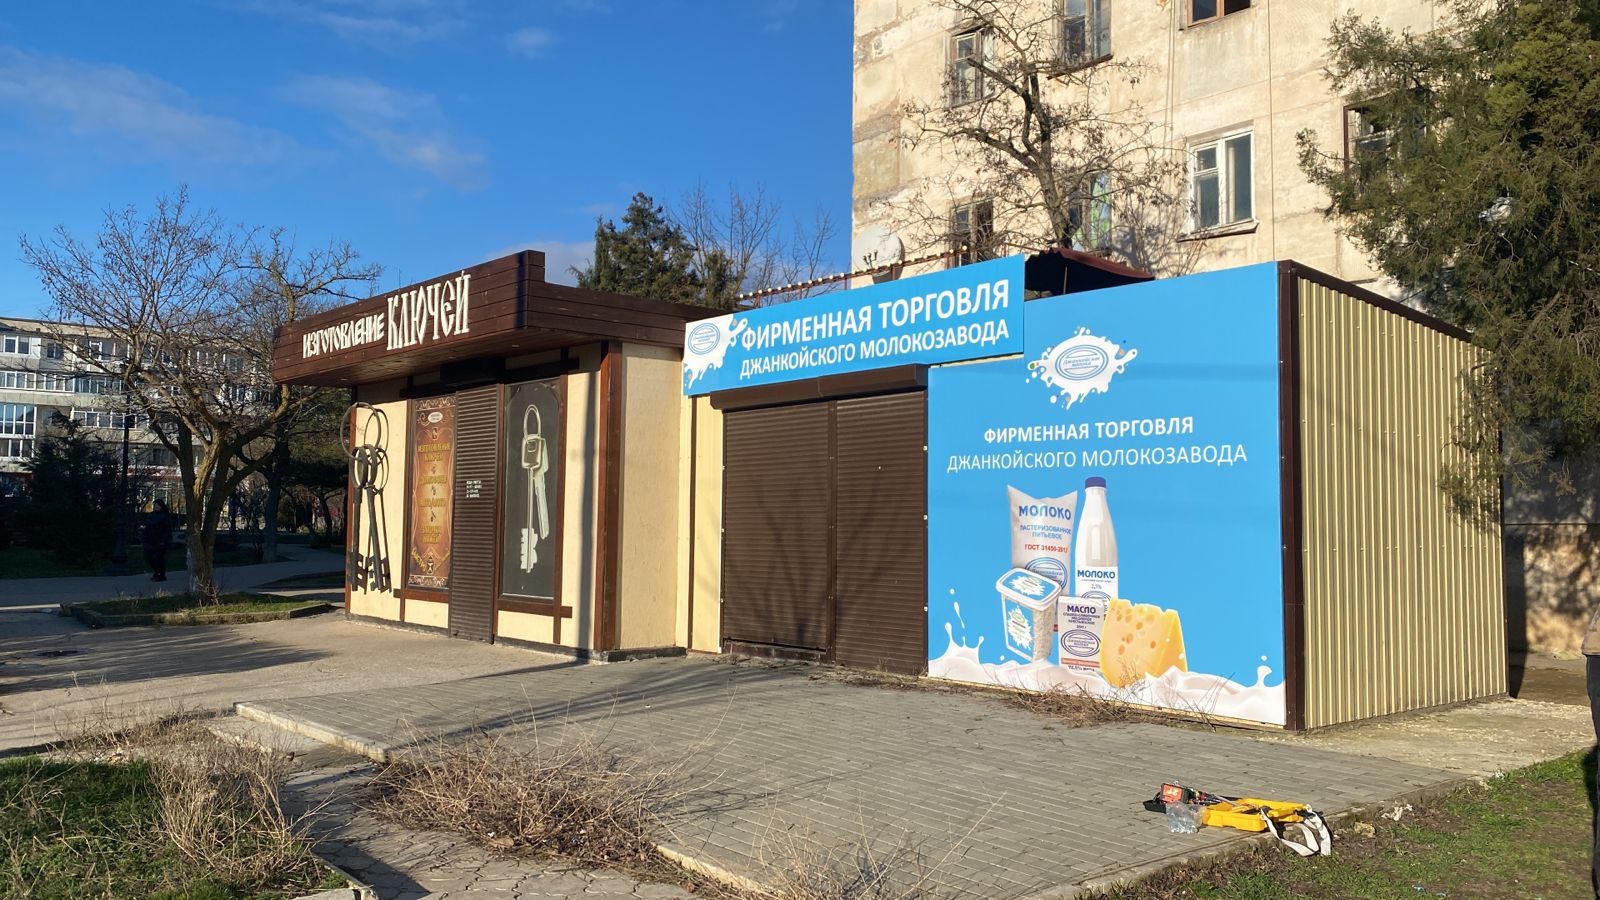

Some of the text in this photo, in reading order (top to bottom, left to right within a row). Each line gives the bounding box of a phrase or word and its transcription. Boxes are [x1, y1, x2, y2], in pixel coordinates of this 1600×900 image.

[303, 271, 471, 358] ИЗГОТОВЛЕНИЕ КЛЮЧЕЙ
[741, 279, 1010, 351] ФИРМЕННАЯ ТОРГОВЛЯ
[740, 319, 1010, 380] ДЖАНКОЙСКОГО МОЛОКОЗАВОДА
[984, 416, 1194, 444] ФИРМЕННАЯ ТОРГОВЛЯ
[947, 444, 1248, 473] ДЖАНКОЙСКОГО МОЛОКОЗАВОДА
[1018, 505, 1071, 520] МОЛОКО
[1077, 569, 1116, 579] МОЛОКО
[1067, 604, 1097, 615] МАСЛО
